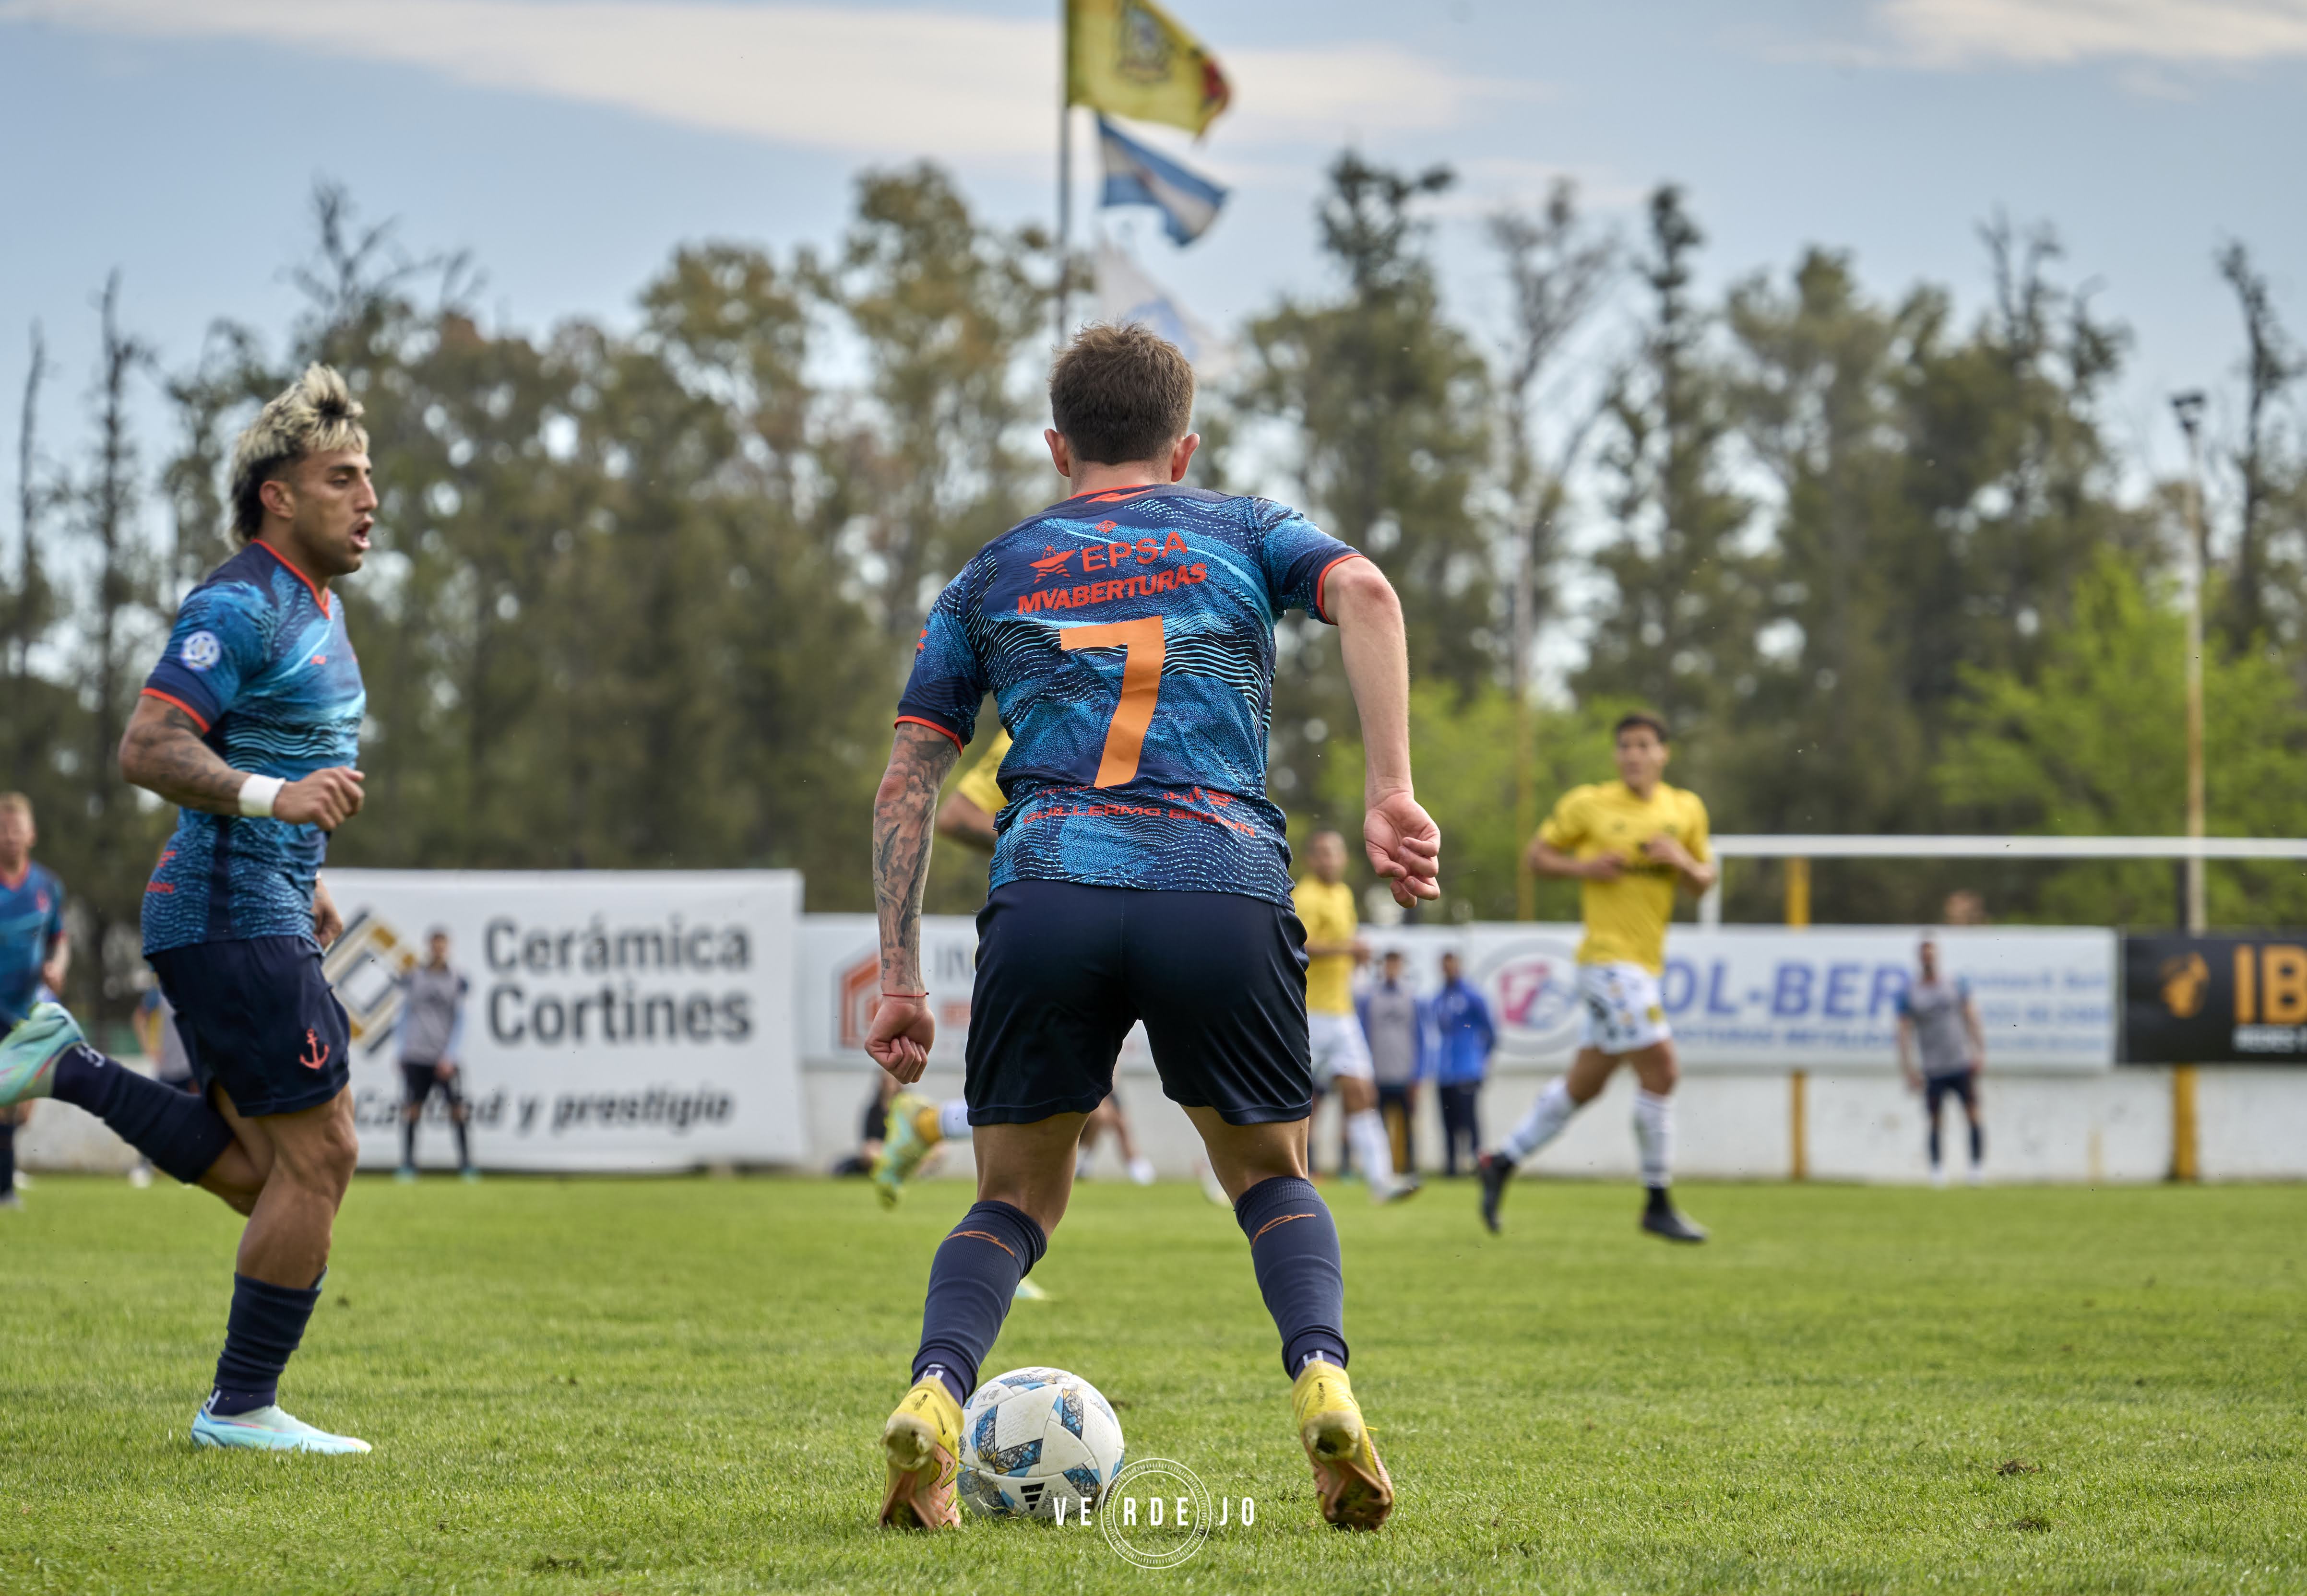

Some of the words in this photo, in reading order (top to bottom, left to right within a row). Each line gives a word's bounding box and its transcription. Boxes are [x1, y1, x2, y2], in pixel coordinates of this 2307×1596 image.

[1082, 532, 1189, 572] EPSA
[1060, 615, 1165, 788] 7
[1023, 804, 1161, 824] GUILLERMO
[484, 913, 751, 973] Cerámica
[488, 981, 753, 1045] Cortines
[1662, 958, 1910, 1017] OL-BER
[518, 1096, 543, 1136] y
[552, 1087, 734, 1138] prestigio
